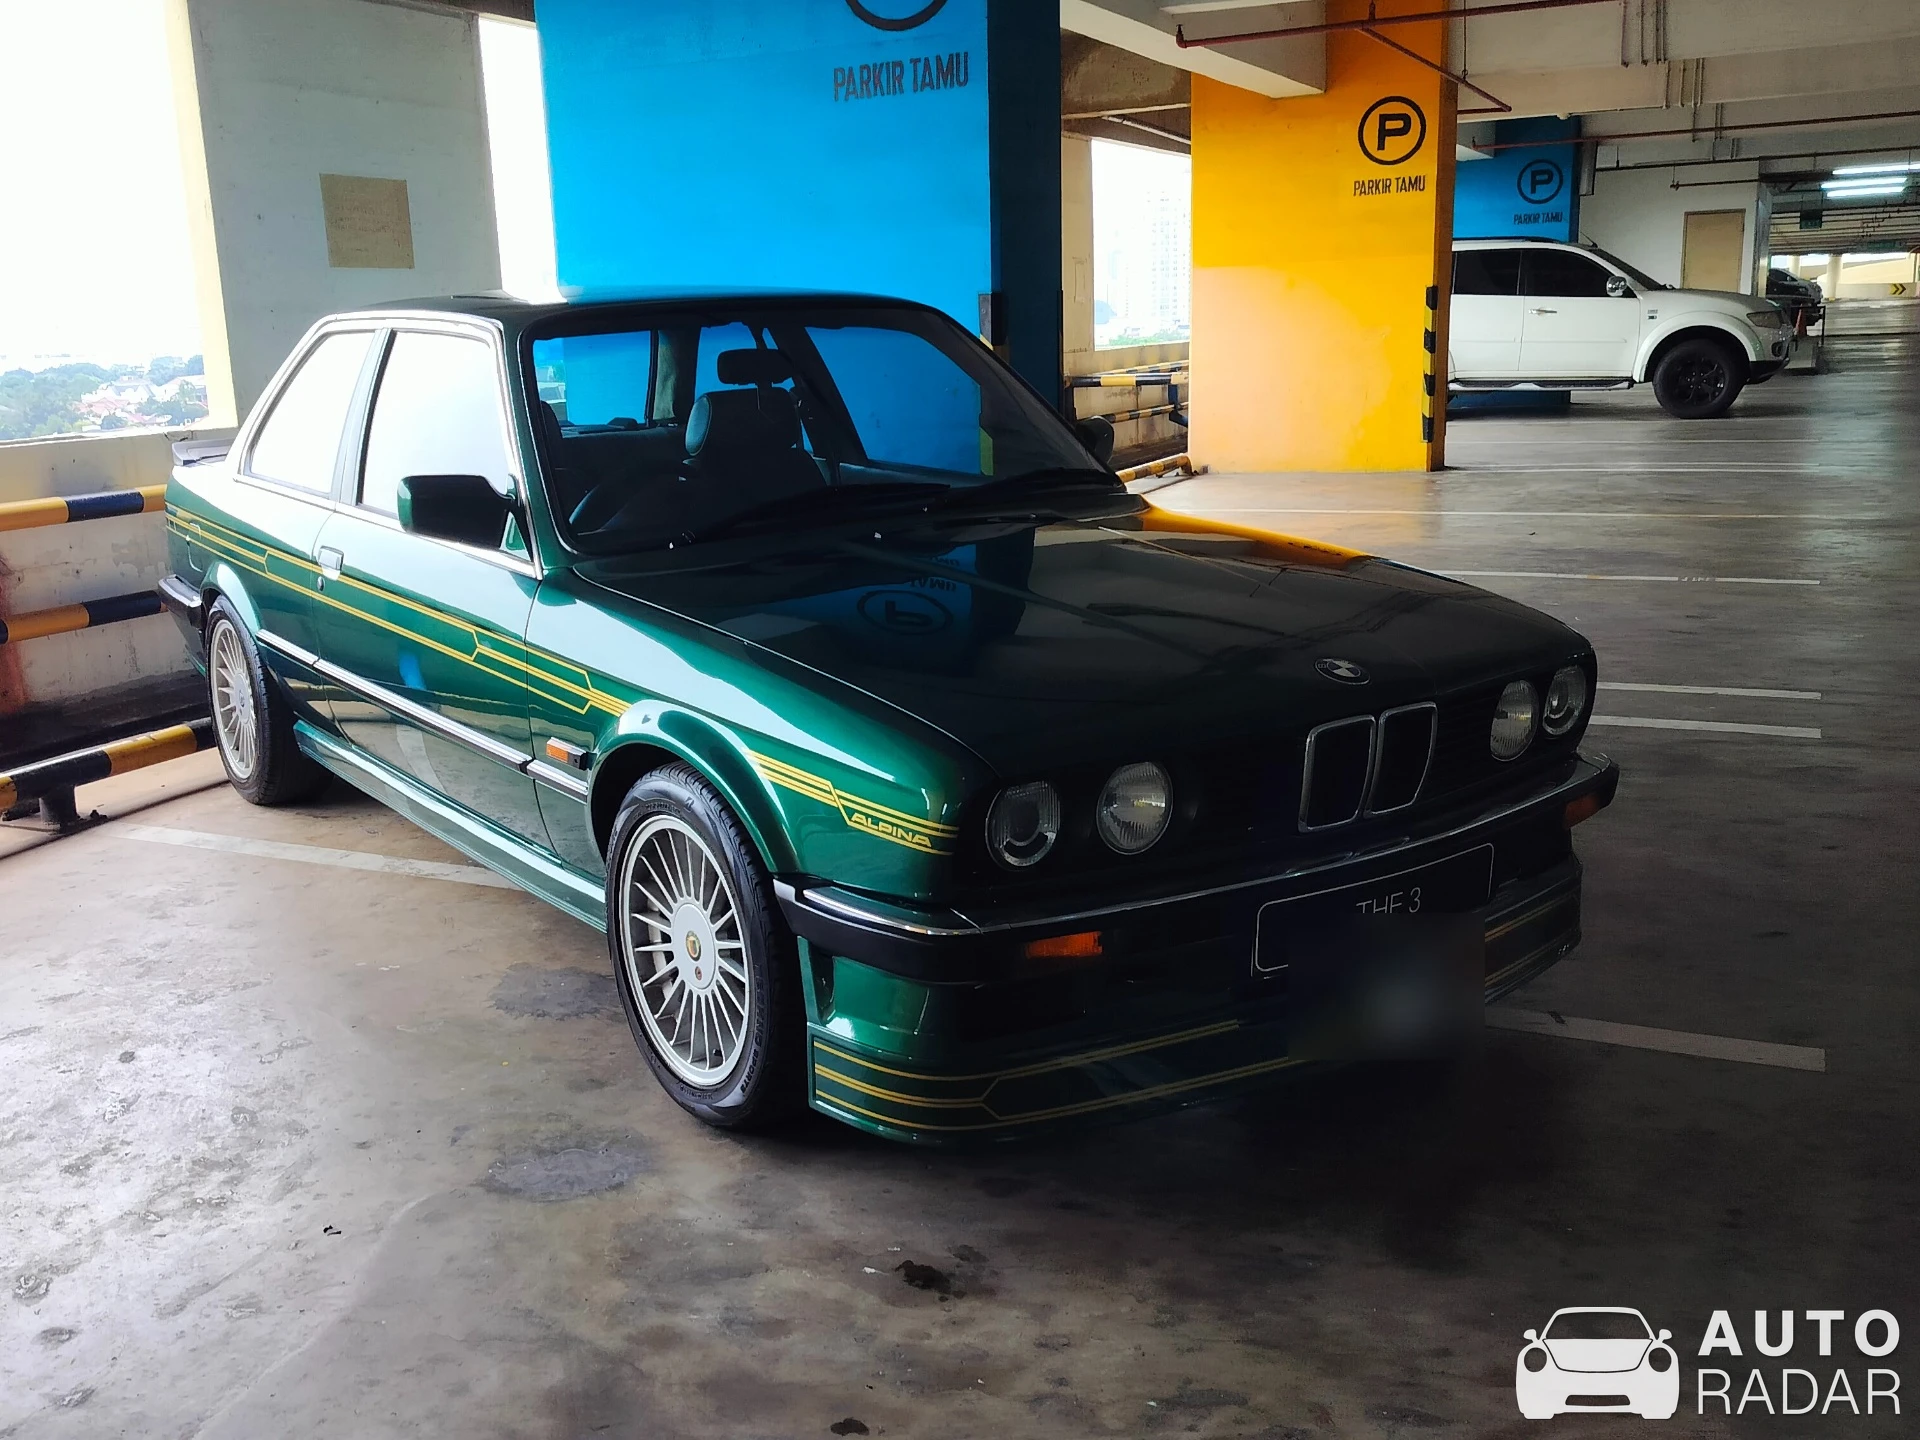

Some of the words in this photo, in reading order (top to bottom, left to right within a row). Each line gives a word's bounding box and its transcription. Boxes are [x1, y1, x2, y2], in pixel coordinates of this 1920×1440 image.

[833, 60, 905, 102] PARKIR
[909, 51, 969, 93] TAMU
[1377, 113, 1412, 151] P
[1353, 178, 1392, 196] PARKIR
[1395, 175, 1426, 194] TAMU
[1530, 169, 1554, 194] P
[1513, 213, 1540, 225] PARKIR
[1541, 212, 1563, 224] TAMU
[850, 812, 932, 847] ALPINA
[1408, 887, 1421, 913] 3
